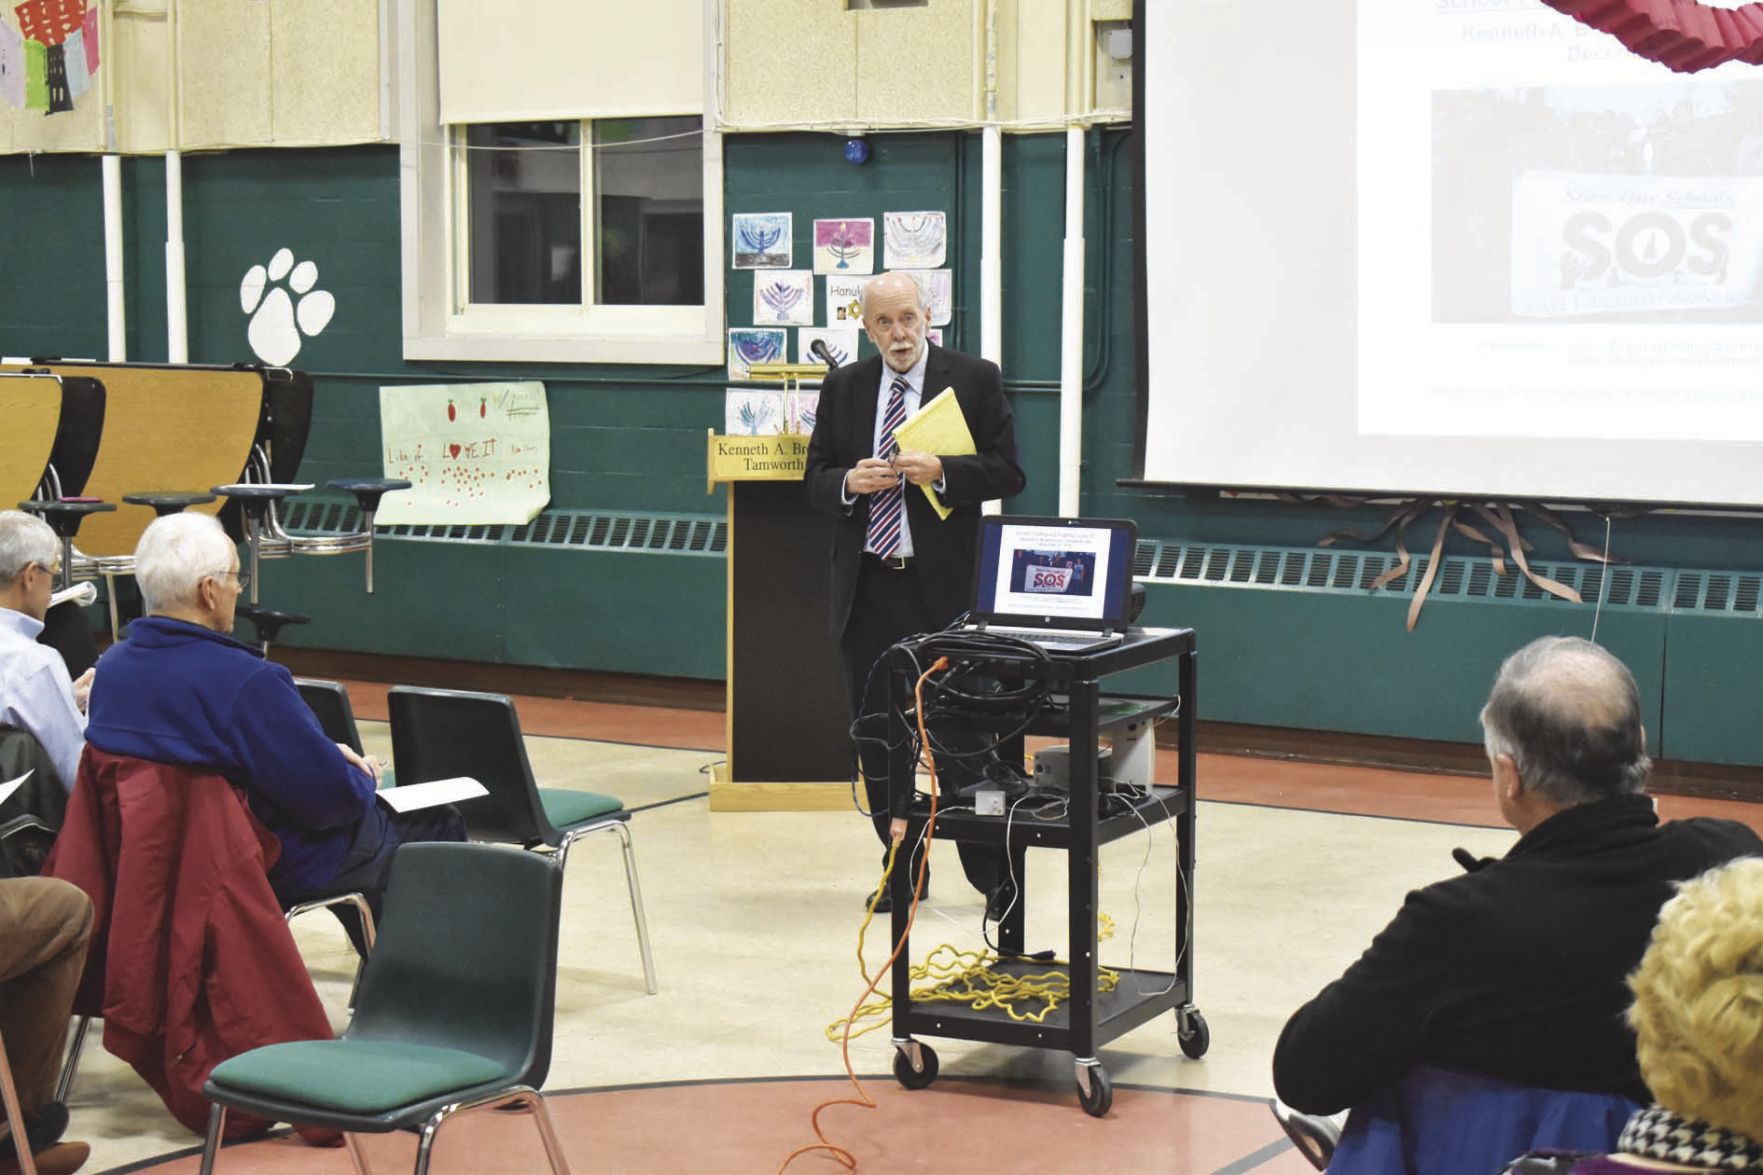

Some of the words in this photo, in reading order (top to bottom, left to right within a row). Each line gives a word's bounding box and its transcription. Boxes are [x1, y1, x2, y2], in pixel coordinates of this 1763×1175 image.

[1562, 210, 1733, 281] SOS
[718, 442, 769, 456] Kenneth
[793, 442, 808, 455] Br
[744, 457, 804, 471] Tamworth
[1034, 572, 1066, 587] SOS
